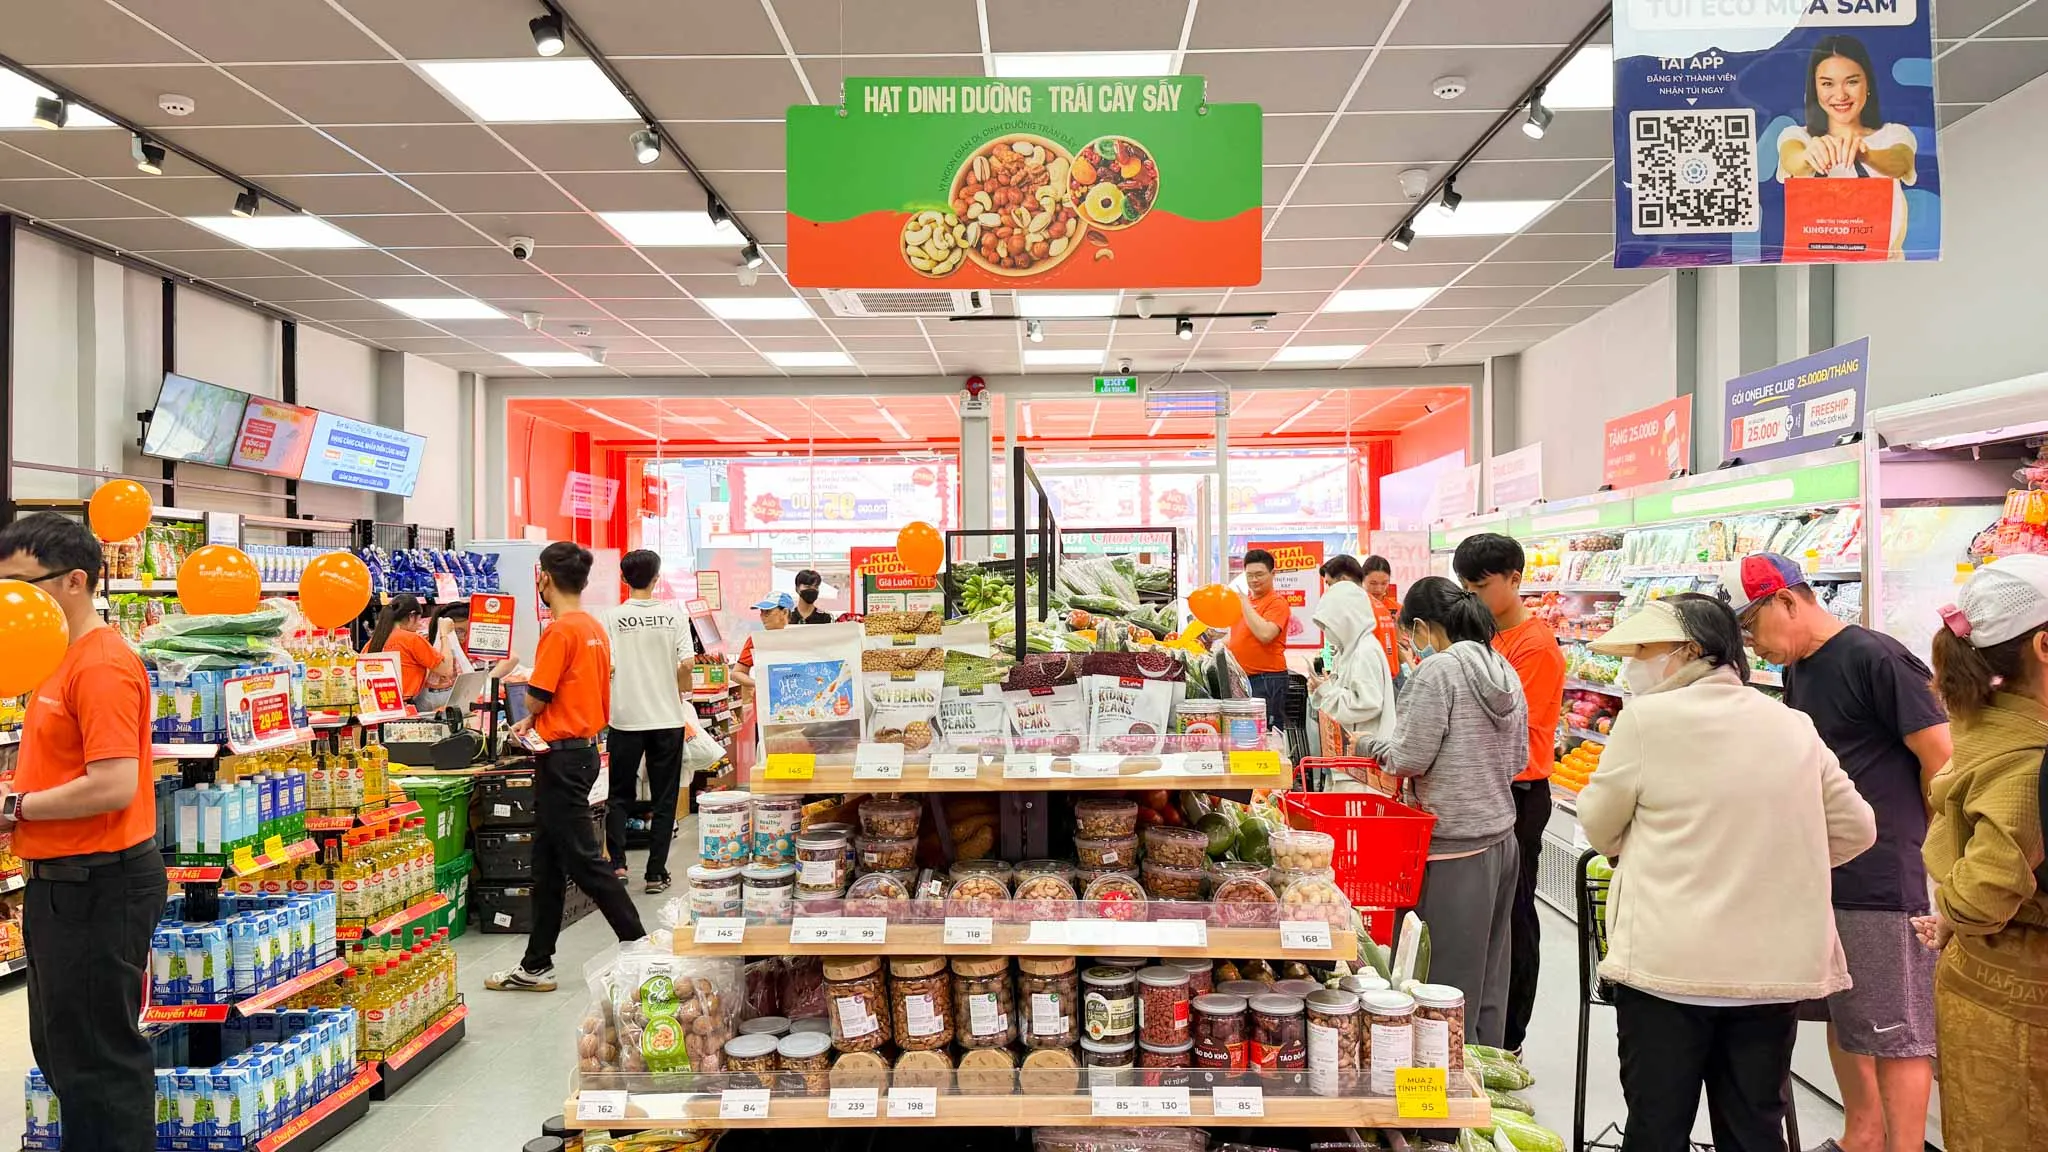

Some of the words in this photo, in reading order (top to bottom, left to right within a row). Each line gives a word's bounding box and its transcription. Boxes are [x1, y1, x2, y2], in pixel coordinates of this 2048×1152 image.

[1689, 56, 1724, 69] APP
[1685, 72, 1715, 82] THÀNH
[1716, 72, 1737, 82] VIÊN
[1700, 86, 1725, 95] NGAY
[864, 85, 903, 117] HẠT
[907, 86, 956, 114] DINH
[961, 81, 1032, 114] DƯỠNG
[1048, 82, 1094, 113] TRÁI
[1098, 81, 1139, 113] CÂY
[1731, 389, 1744, 406] GÓI
[1744, 383, 1775, 402] ONELIFE
[1774, 378, 1796, 394] CLUB
[1810, 398, 1849, 418] FREESHIP
[870, 553, 899, 565] KHA
[859, 562, 907, 575] TRƯƠN
[879, 576, 893, 588] Giá
[893, 576, 913, 587] Luôn
[1098, 689, 1137, 707] KIDNEY
[940, 702, 973, 718] MUNG
[1098, 703, 1133, 716] BEANS
[941, 716, 977, 730] BEANS
[1018, 718, 1051, 731] BEANS
[175, 724, 193, 733] Milk
[1201, 762, 1213, 770] 59
[304, 819, 329, 829] uyến
[336, 928, 358, 939] uyến
[717, 929, 734, 938] 145
[815, 929, 828, 938] 99
[862, 929, 875, 938] 99
[966, 930, 981, 938] 118
[1301, 934, 1318, 944] 168
[153, 985, 171, 994] Milk
[187, 985, 205, 994] Milk
[146, 1008, 186, 1020] Khuyến
[187, 1007, 207, 1018] Mãi
[1213, 1052, 1229, 1060] KHÔ
[1398, 1084, 1417, 1092] TÍNH
[597, 1105, 613, 1113] 162
[743, 1104, 756, 1112] 84
[847, 1102, 865, 1111] 239
[907, 1102, 924, 1111] 198
[1116, 1102, 1129, 1110] 85
[1161, 1101, 1178, 1110] 130
[1238, 1101, 1251, 1110] 85
[1421, 1103, 1434, 1111] 95
[178, 1128, 196, 1137] Milk
[213, 1128, 232, 1137] Milk
